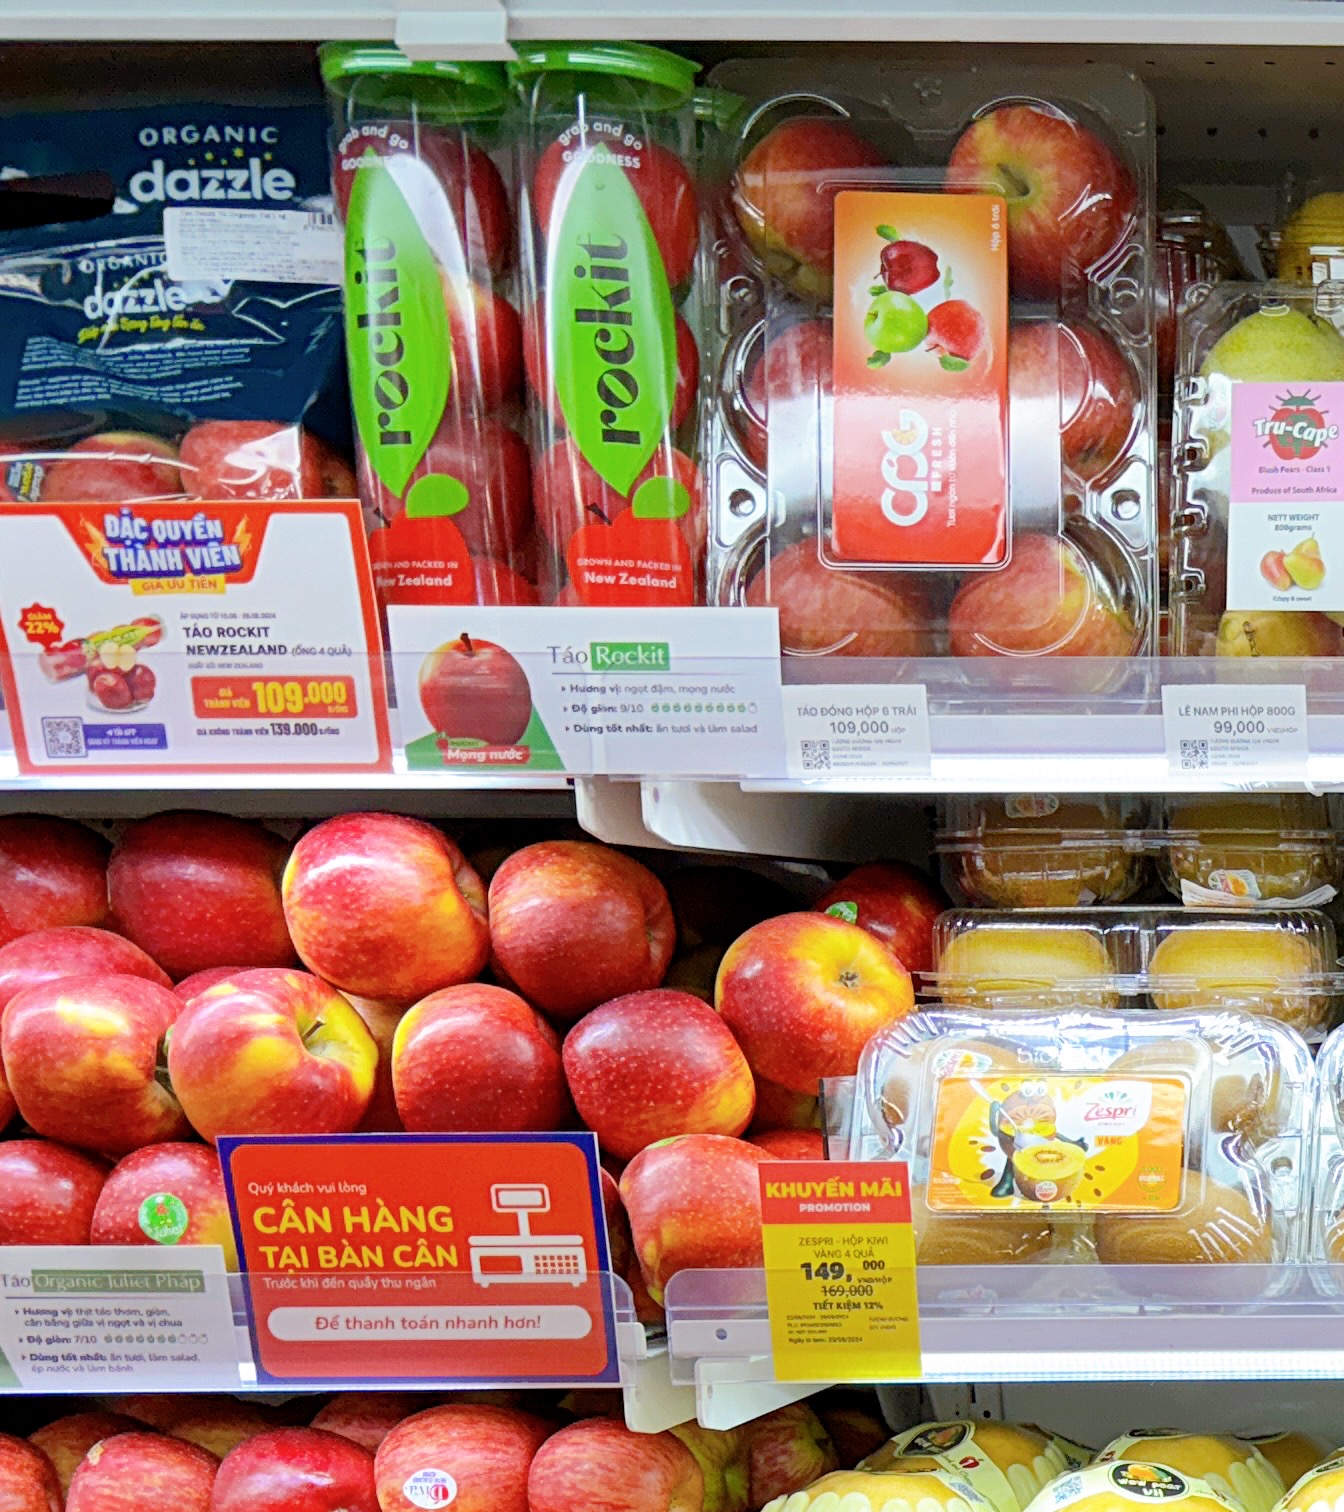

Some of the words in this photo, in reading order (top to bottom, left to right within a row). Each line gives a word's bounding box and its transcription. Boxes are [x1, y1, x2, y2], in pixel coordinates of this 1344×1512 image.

[139, 124, 280, 147] ORGANIC
[129, 157, 297, 203] dazzle
[354, 234, 413, 447] rockit
[573, 232, 642, 446] rockit
[1253, 415, 1340, 448] Tru-Cape
[103, 508, 149, 546] ĐẶC
[151, 512, 224, 545] QUYỀN
[103, 544, 186, 575] THÀNH
[189, 543, 242, 571] VIÊN
[584, 571, 617, 586] New
[619, 573, 678, 590] Zealand
[182, 622, 214, 639] TÁO
[216, 625, 271, 639] ROCKIT
[185, 643, 289, 658] NEWZEALAND
[546, 642, 588, 665] Táo
[595, 644, 666, 667] Rockit
[252, 681, 348, 715] 109.000
[1192, 706, 1218, 717] NAM
[1219, 706, 1238, 717] PHI
[1240, 704, 1264, 719] HỘP
[1265, 705, 1296, 717] 800G
[829, 720, 890, 737] 109,000
[1213, 720, 1265, 737] 99,000
[1084, 1102, 1138, 1123] Zespri
[247, 1181, 276, 1197] Quý
[277, 1180, 315, 1195] khách
[316, 1181, 336, 1195] vui
[337, 1180, 368, 1197] lòng
[766, 1176, 855, 1199] KHUYẾN
[861, 1176, 903, 1198] MÃI
[252, 1199, 333, 1235] CÂN
[343, 1196, 455, 1234] HÀNG
[258, 1243, 311, 1277] TẠI
[320, 1238, 387, 1269] BÀN
[391, 1236, 459, 1269] CÂN
[315, 1312, 339, 1332] Để
[341, 1314, 397, 1332] thanh
[400, 1313, 441, 1332] toán
[444, 1313, 500, 1332] nhanh
[503, 1313, 541, 1332] hơn!
